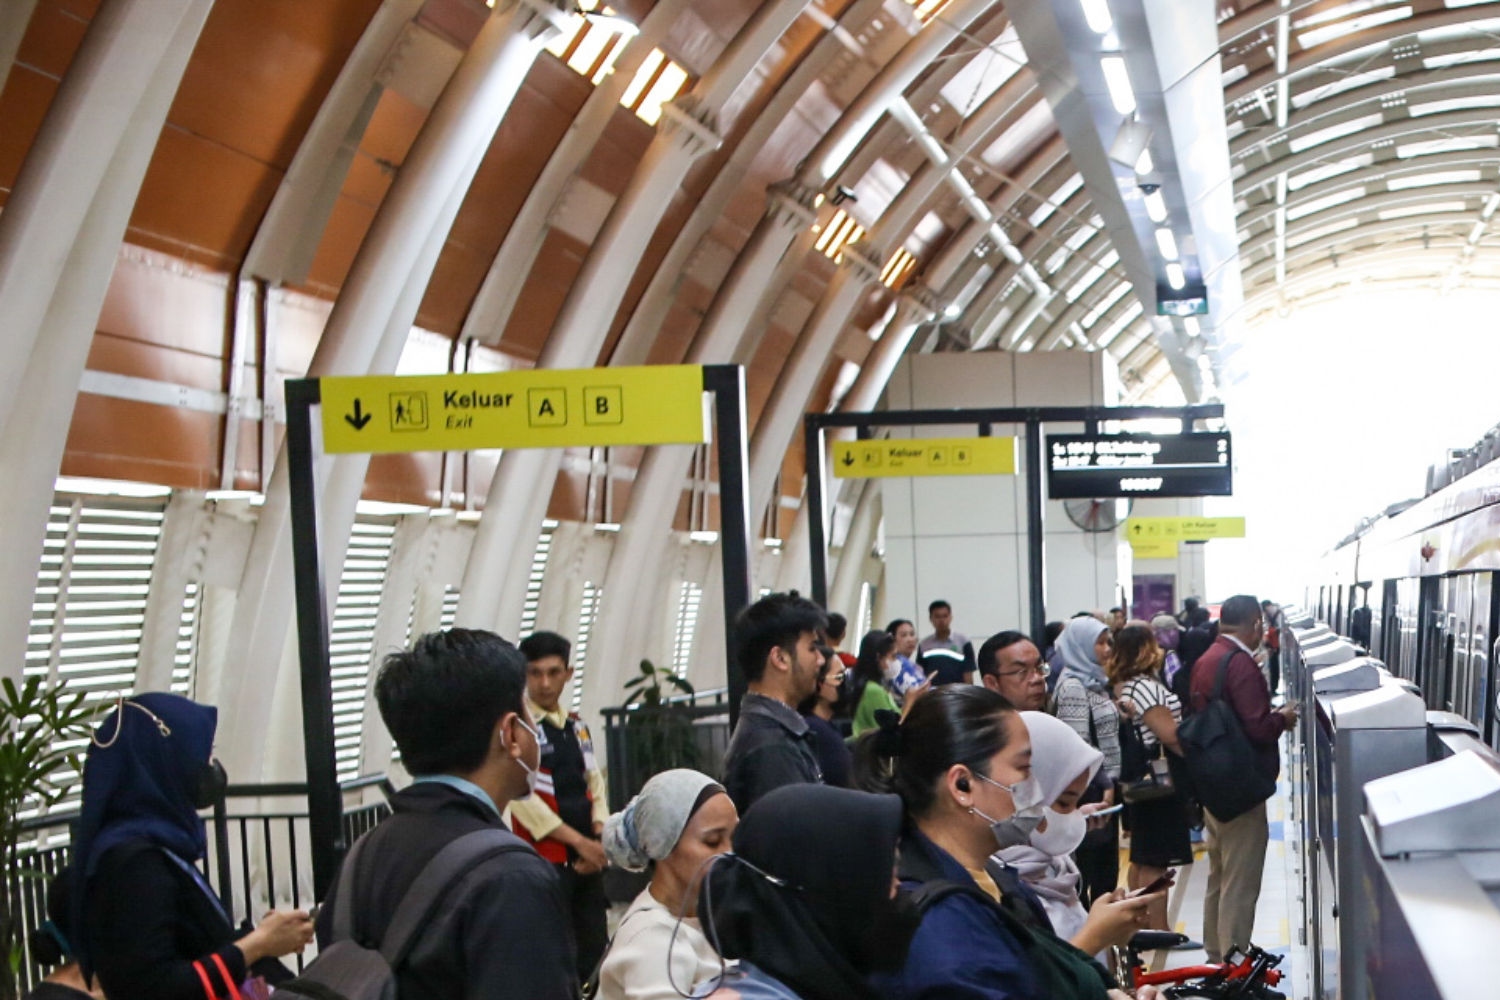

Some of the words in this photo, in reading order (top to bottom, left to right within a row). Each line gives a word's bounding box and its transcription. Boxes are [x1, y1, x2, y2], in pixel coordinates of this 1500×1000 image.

[442, 389, 514, 411] Keluar
[537, 398, 555, 417] A
[595, 397, 609, 415] B
[445, 414, 473, 430] Exit
[888, 447, 923, 459] Keluar
[932, 451, 941, 461] A
